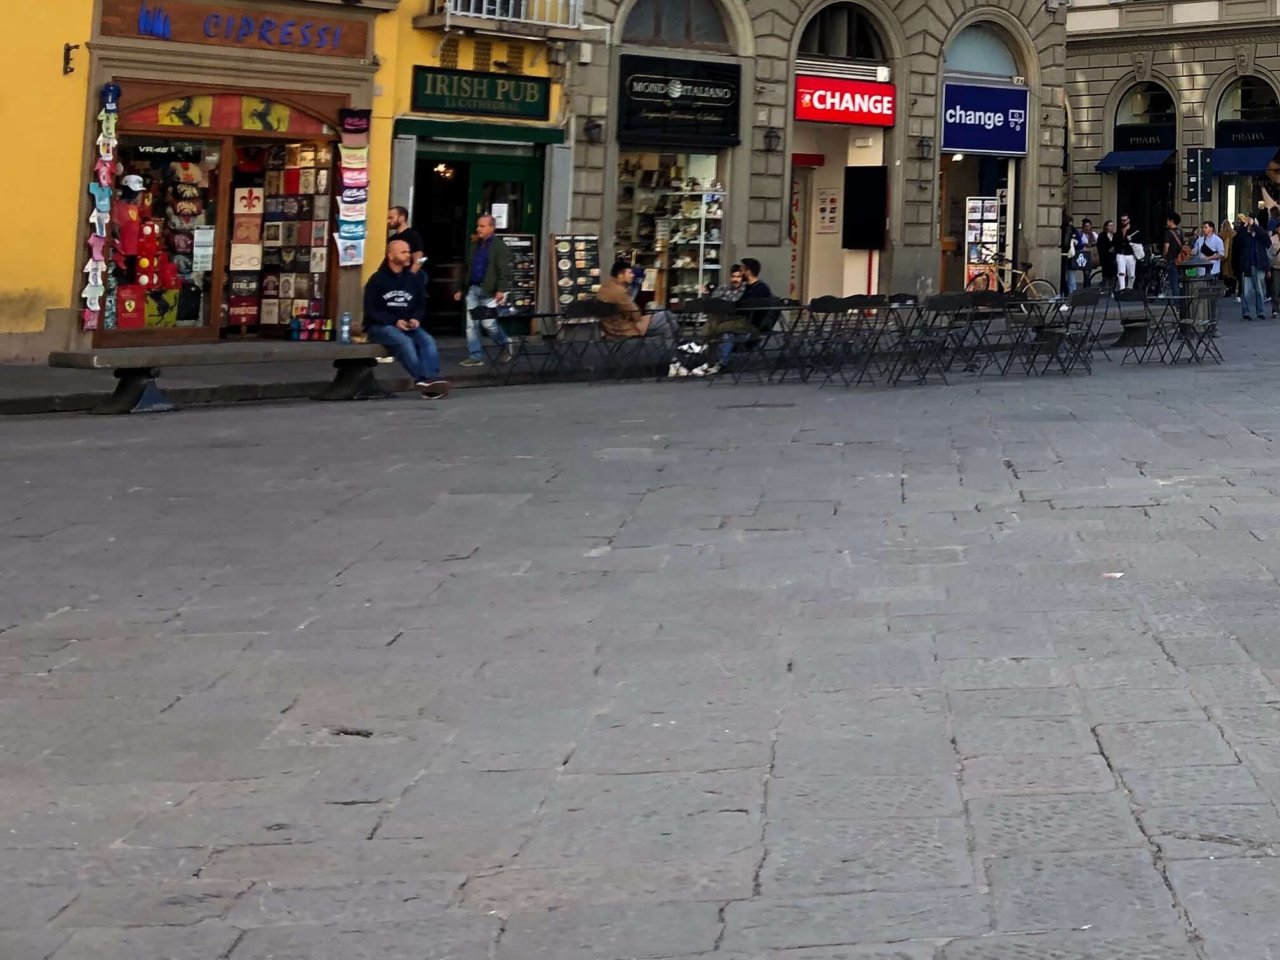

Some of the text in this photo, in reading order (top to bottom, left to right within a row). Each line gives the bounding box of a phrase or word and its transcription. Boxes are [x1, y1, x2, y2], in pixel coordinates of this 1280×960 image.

[203, 10, 344, 50] CIPRESSI
[425, 73, 540, 103] IRISH PUB
[812, 90, 893, 115] CHANGE
[945, 105, 1004, 130] change
[1130, 136, 1161, 144] PRADA
[1232, 132, 1265, 141] PRADA
